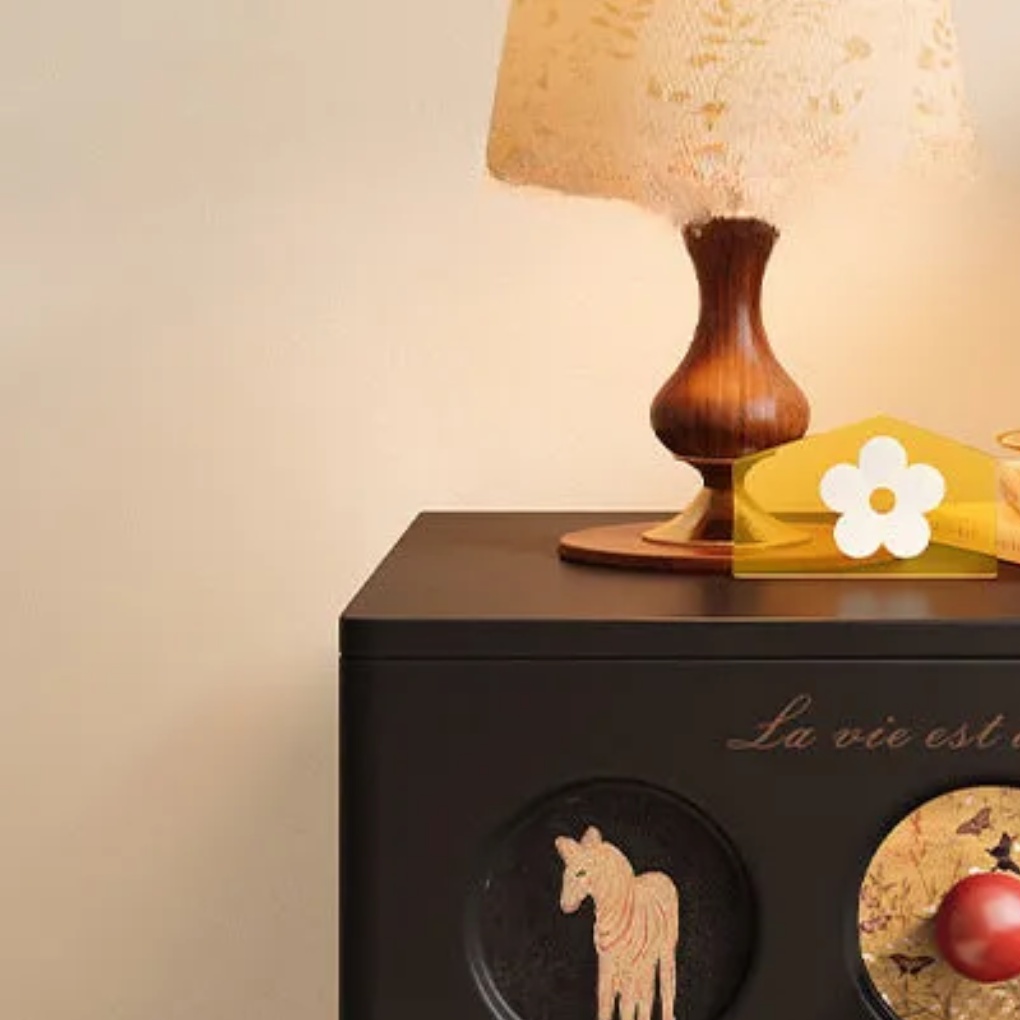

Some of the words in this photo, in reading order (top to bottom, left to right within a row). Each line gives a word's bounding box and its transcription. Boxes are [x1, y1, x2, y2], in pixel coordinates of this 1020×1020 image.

[727, 694, 815, 751] La
[833, 715, 912, 750] vie
[924, 711, 1004, 750] est
